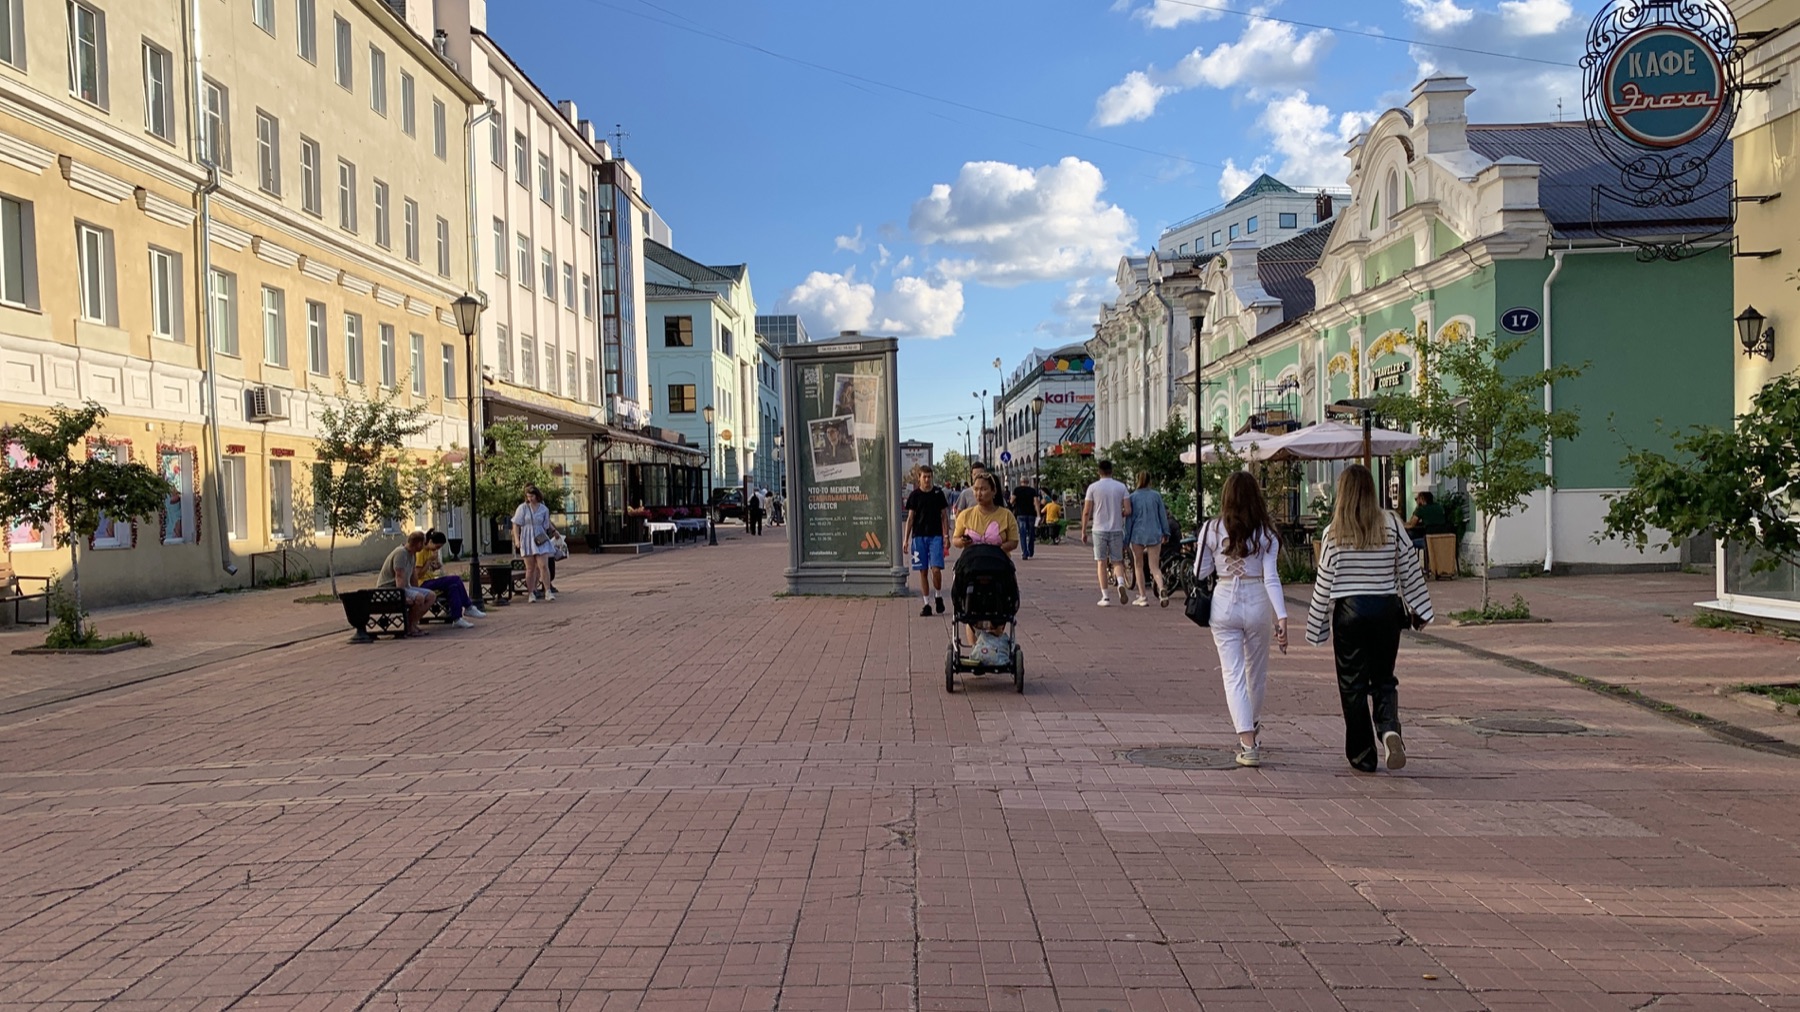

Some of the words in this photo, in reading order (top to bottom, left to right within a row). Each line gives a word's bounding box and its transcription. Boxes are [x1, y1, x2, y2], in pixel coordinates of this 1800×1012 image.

[1629, 49, 1696, 78] КАФЕ
[1611, 83, 1719, 115] Эпоха
[1511, 314, 1529, 327] 17
[1375, 361, 1406, 378] TRAVELER'S
[1379, 374, 1400, 388] COFFEE
[1045, 391, 1075, 404] kari
[531, 423, 559, 432] море
[808, 486, 829, 494] ЧТО-ТО
[829, 485, 862, 494] МЕНЯЕТСЯ,
[847, 493, 869, 501] РАБОТА
[808, 502, 838, 510] ОСТАЕТСЯ
